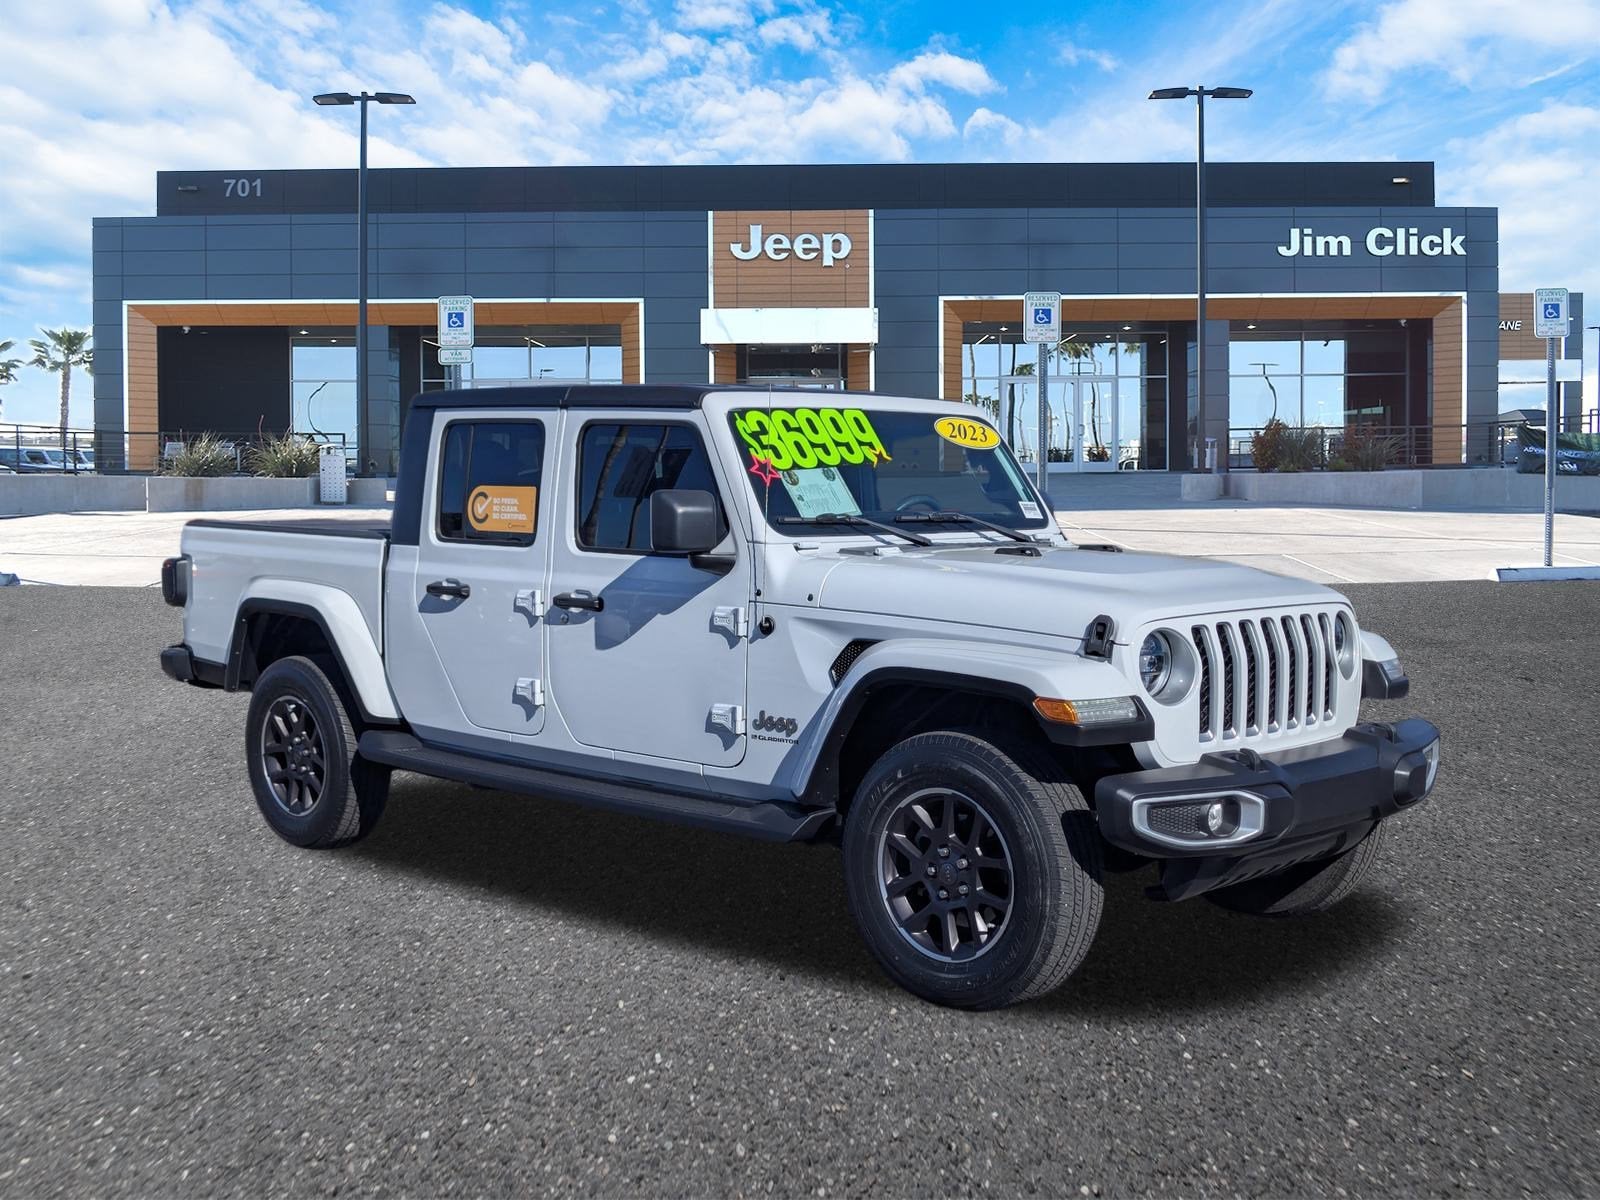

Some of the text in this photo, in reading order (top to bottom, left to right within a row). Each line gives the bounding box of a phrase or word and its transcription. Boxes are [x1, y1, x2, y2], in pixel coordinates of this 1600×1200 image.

[223, 178, 262, 196] 701
[730, 224, 852, 267] Jeep
[1277, 227, 1467, 257] Jim Click
[736, 408, 886, 470] $36999
[947, 422, 990, 443] 2023
[752, 710, 798, 738] Jeep
[758, 735, 799, 744] GLADIATOR
